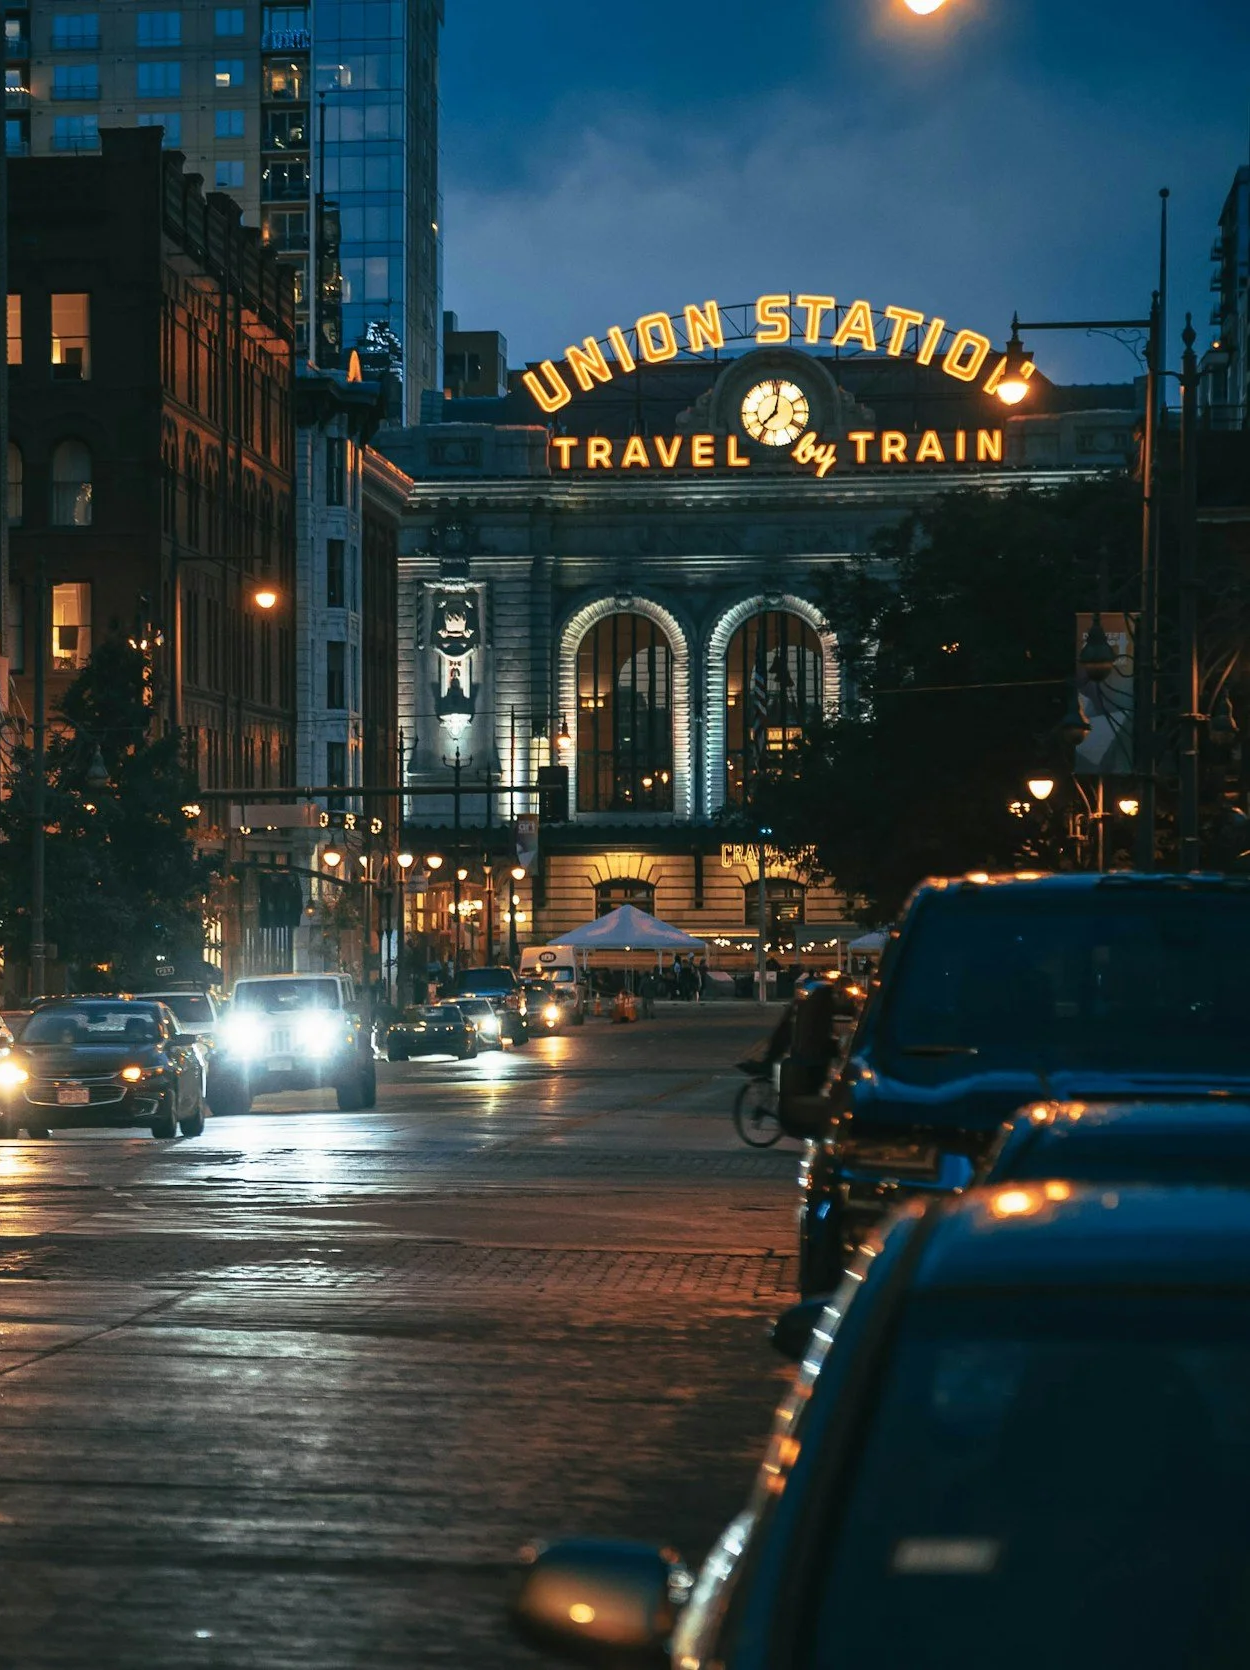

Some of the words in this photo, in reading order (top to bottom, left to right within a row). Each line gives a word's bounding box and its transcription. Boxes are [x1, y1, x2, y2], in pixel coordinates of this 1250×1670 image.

[522, 299, 725, 414] UNION
[754, 293, 1036, 396] STATIO
[552, 433, 750, 470] TRAVEL
[791, 431, 838, 478] by
[848, 428, 1003, 464] TRAIN
